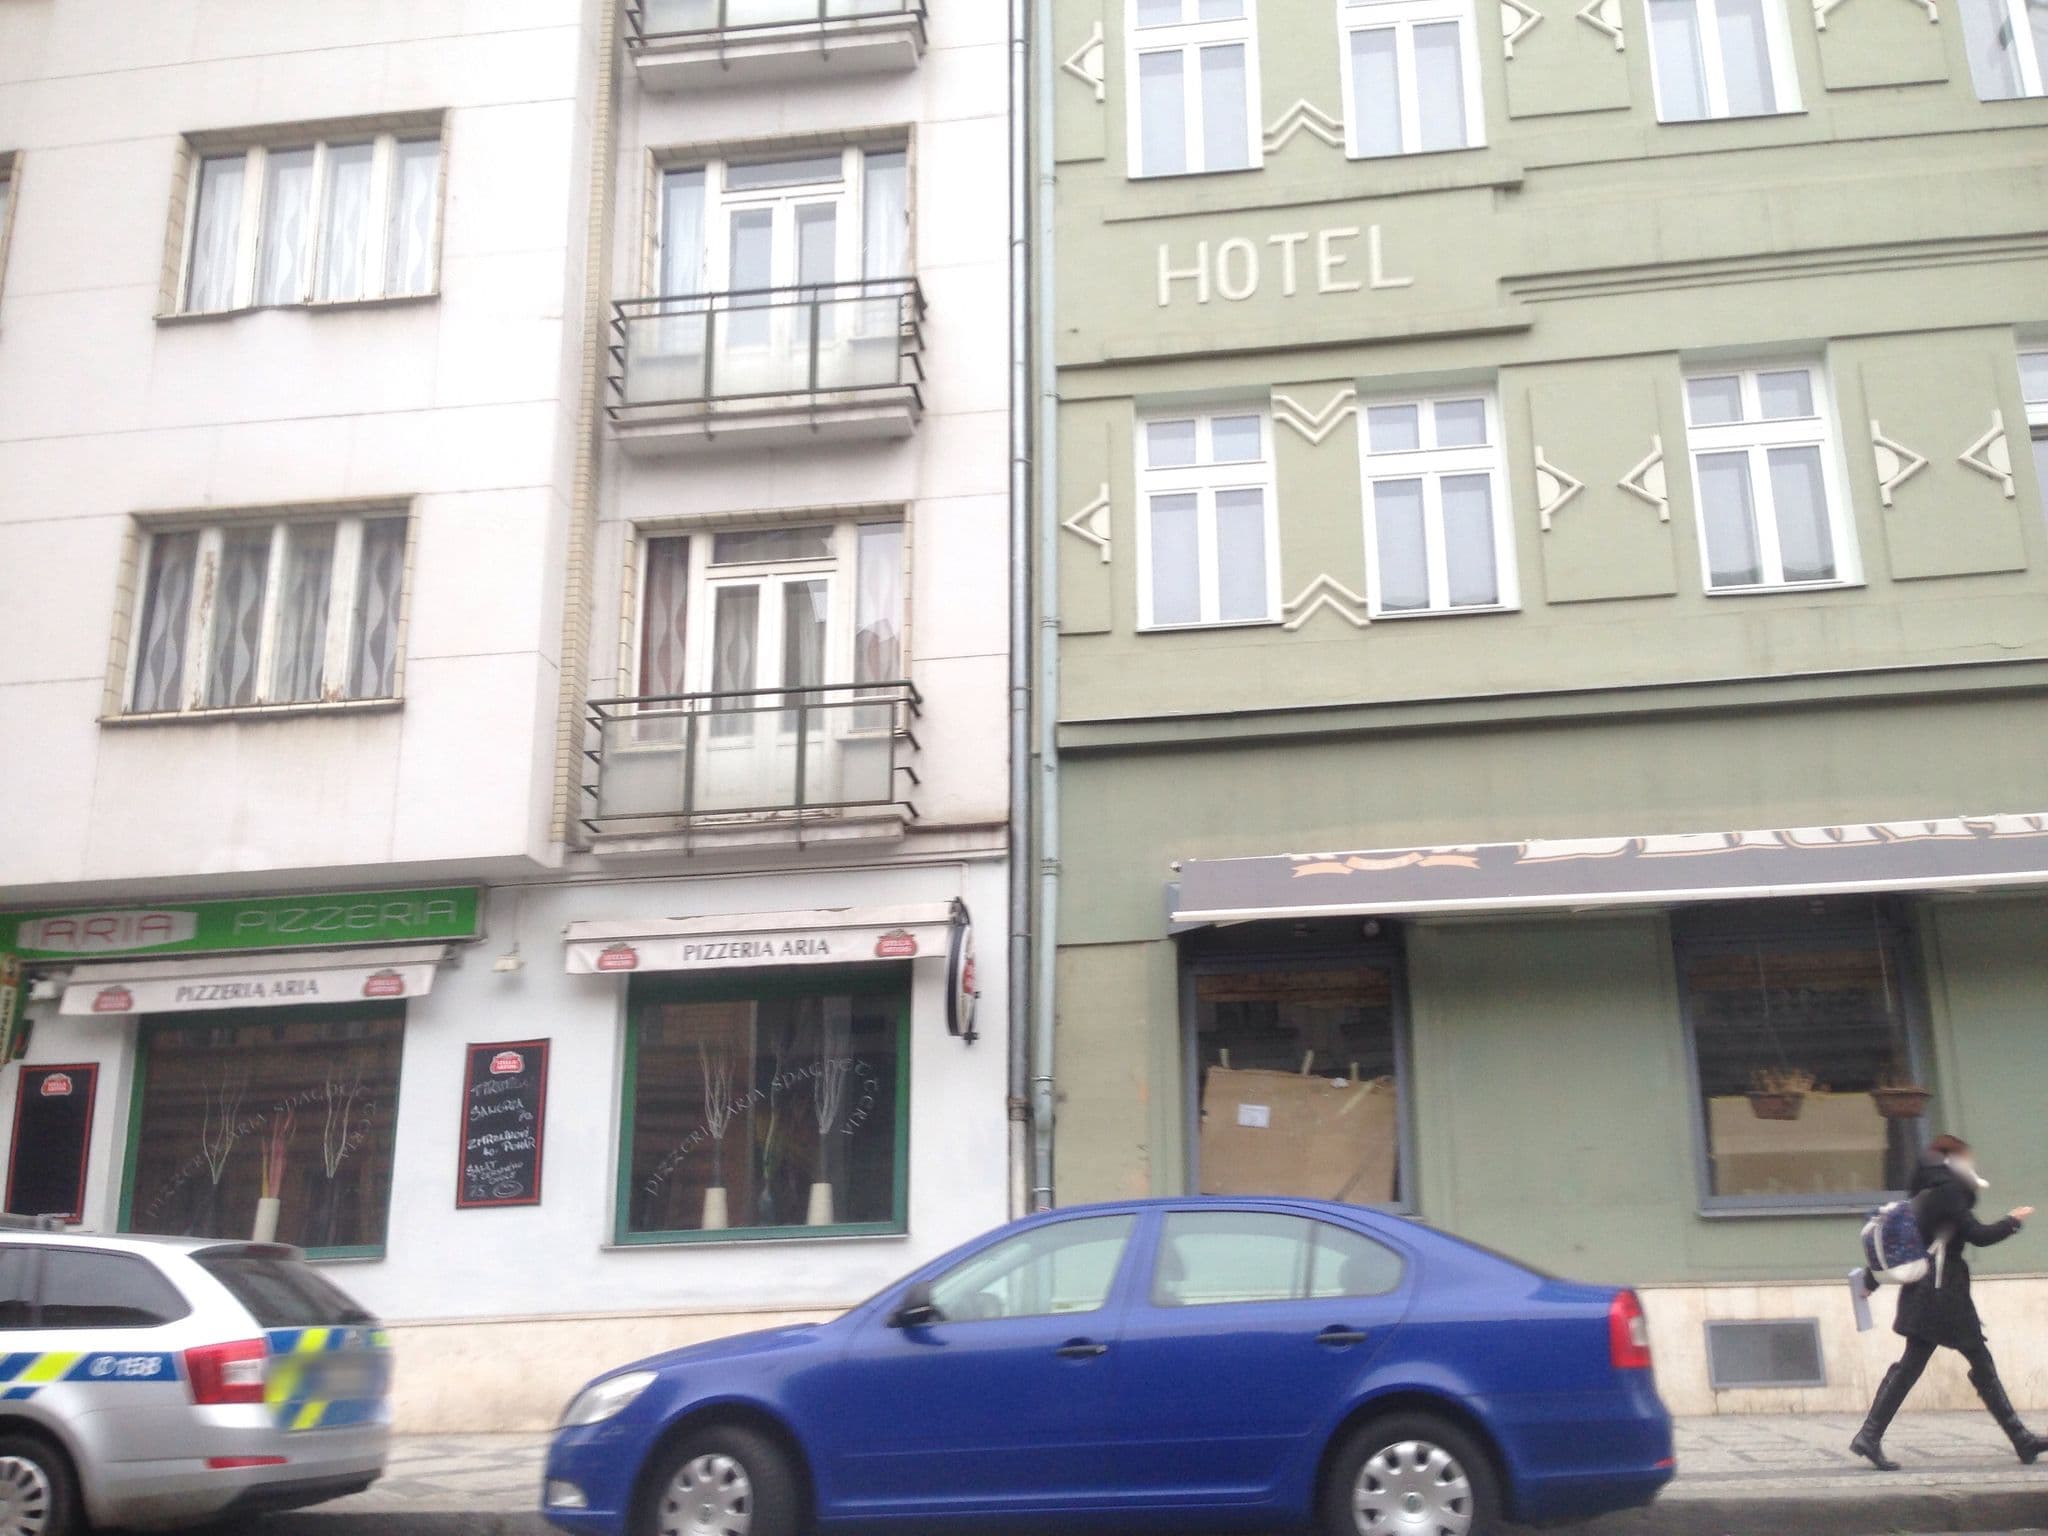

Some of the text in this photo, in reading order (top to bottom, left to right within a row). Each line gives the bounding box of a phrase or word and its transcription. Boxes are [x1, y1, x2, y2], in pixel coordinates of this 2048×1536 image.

[1157, 224, 1414, 307] HOTEL
[41, 900, 457, 947] ARIA PIZZERIA
[684, 938, 831, 962] PIZZERIA ARIA
[175, 979, 319, 1003] PIZZERIA ARIA
